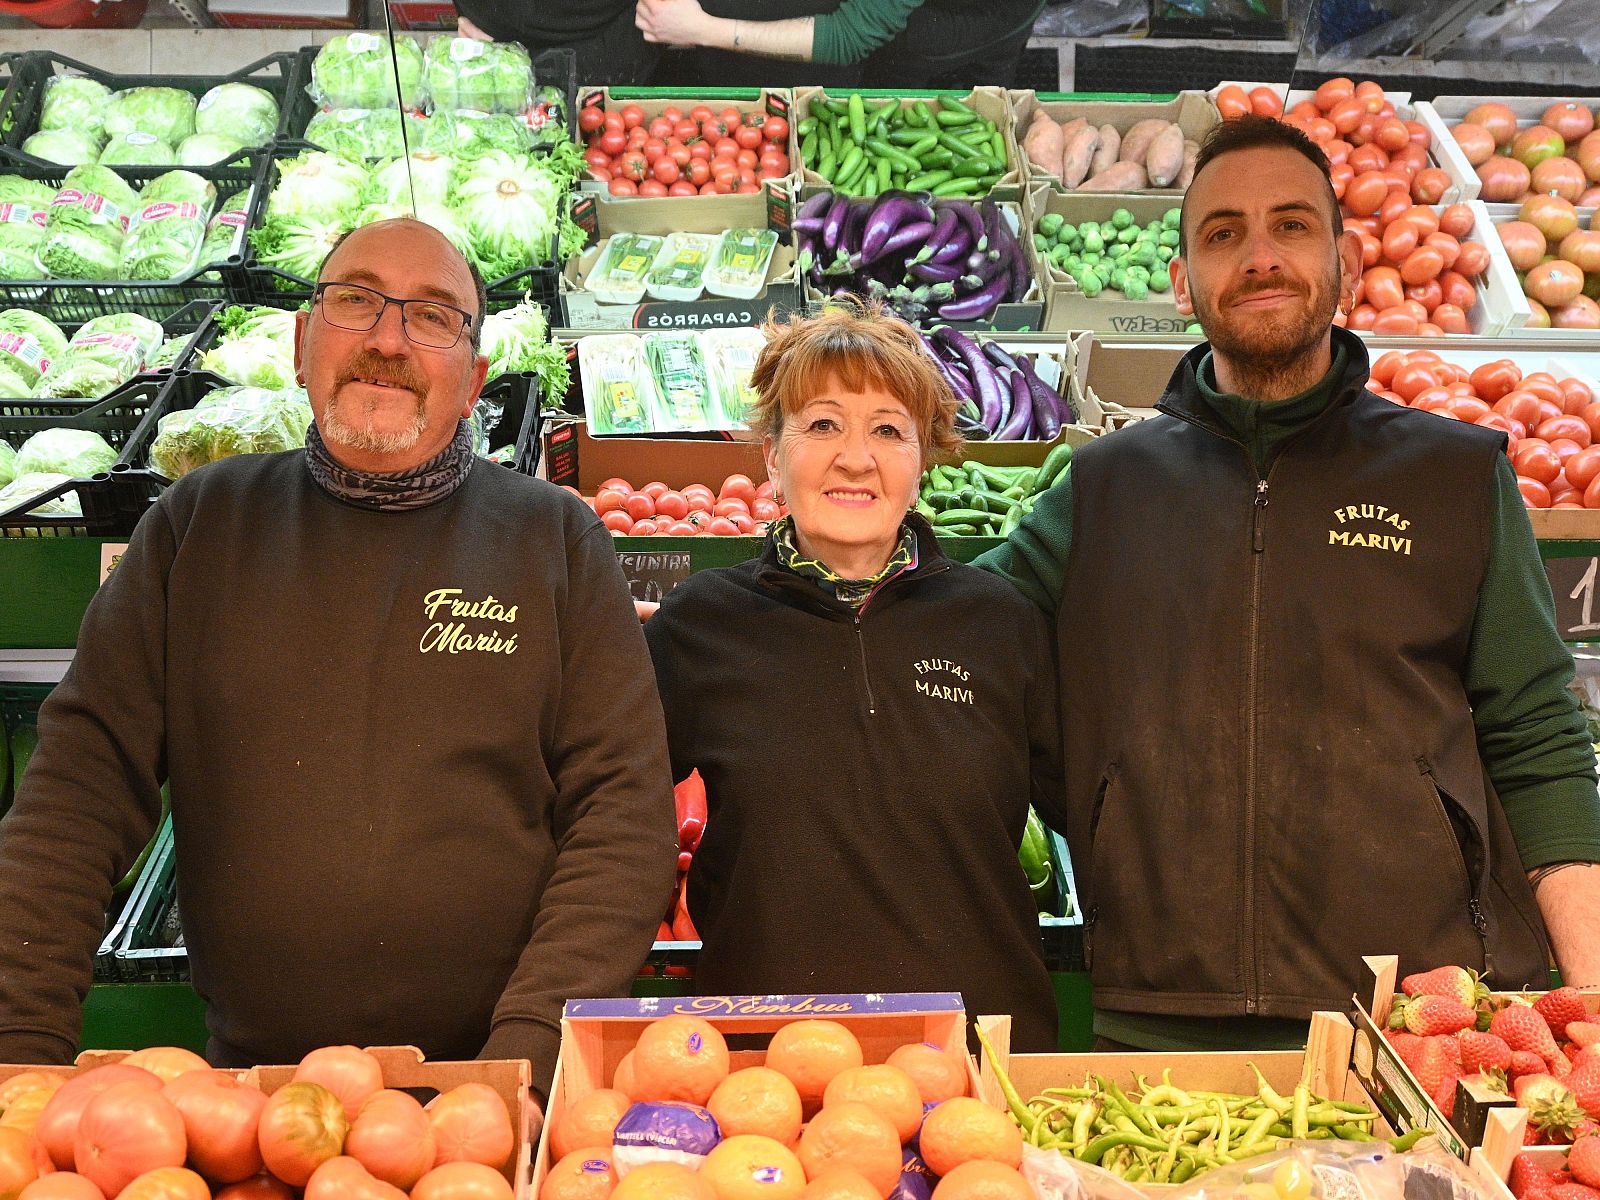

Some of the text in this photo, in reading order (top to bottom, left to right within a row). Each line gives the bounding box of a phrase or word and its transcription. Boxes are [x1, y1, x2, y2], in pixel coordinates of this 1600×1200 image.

[1333, 503, 1411, 531] FRUTAS
[1328, 530, 1412, 555] MARIVI
[423, 588, 519, 623] Frutas
[419, 621, 518, 655] Mariví
[913, 658, 971, 682] FRUTAS
[673, 996, 853, 1015] Nimbus
